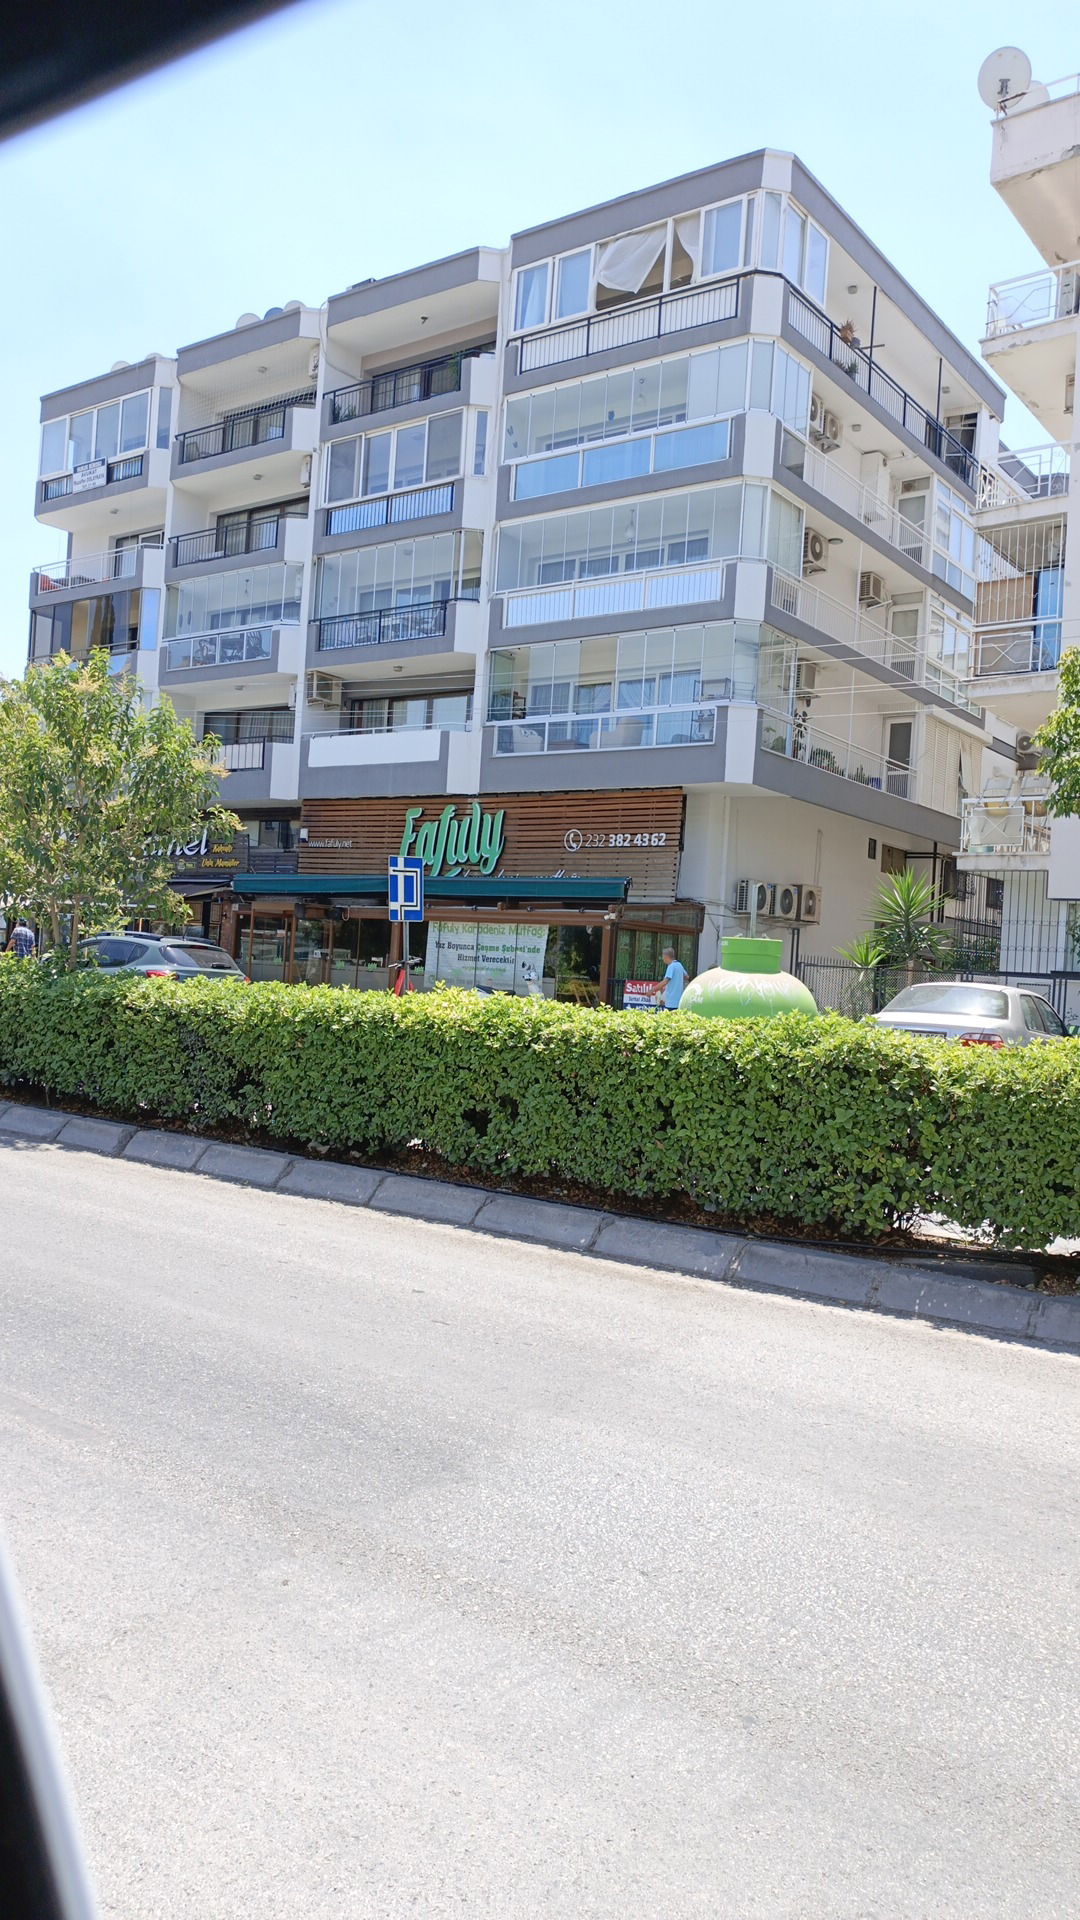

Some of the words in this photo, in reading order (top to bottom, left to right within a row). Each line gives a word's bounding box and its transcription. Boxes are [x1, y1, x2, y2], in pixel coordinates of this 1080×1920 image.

[308, 838, 353, 850] www.fafuly.net
[400, 802, 504, 877] Fafuly
[585, 833, 606, 848] 232
[608, 833, 631, 847] 382
[462, 923, 506, 936] Karadeniz
[435, 940, 446, 950] Yaz
[447, 941, 475, 952] Boyunca
[457, 953, 480, 962] Hizmet
[481, 954, 515, 965] Verecektir
